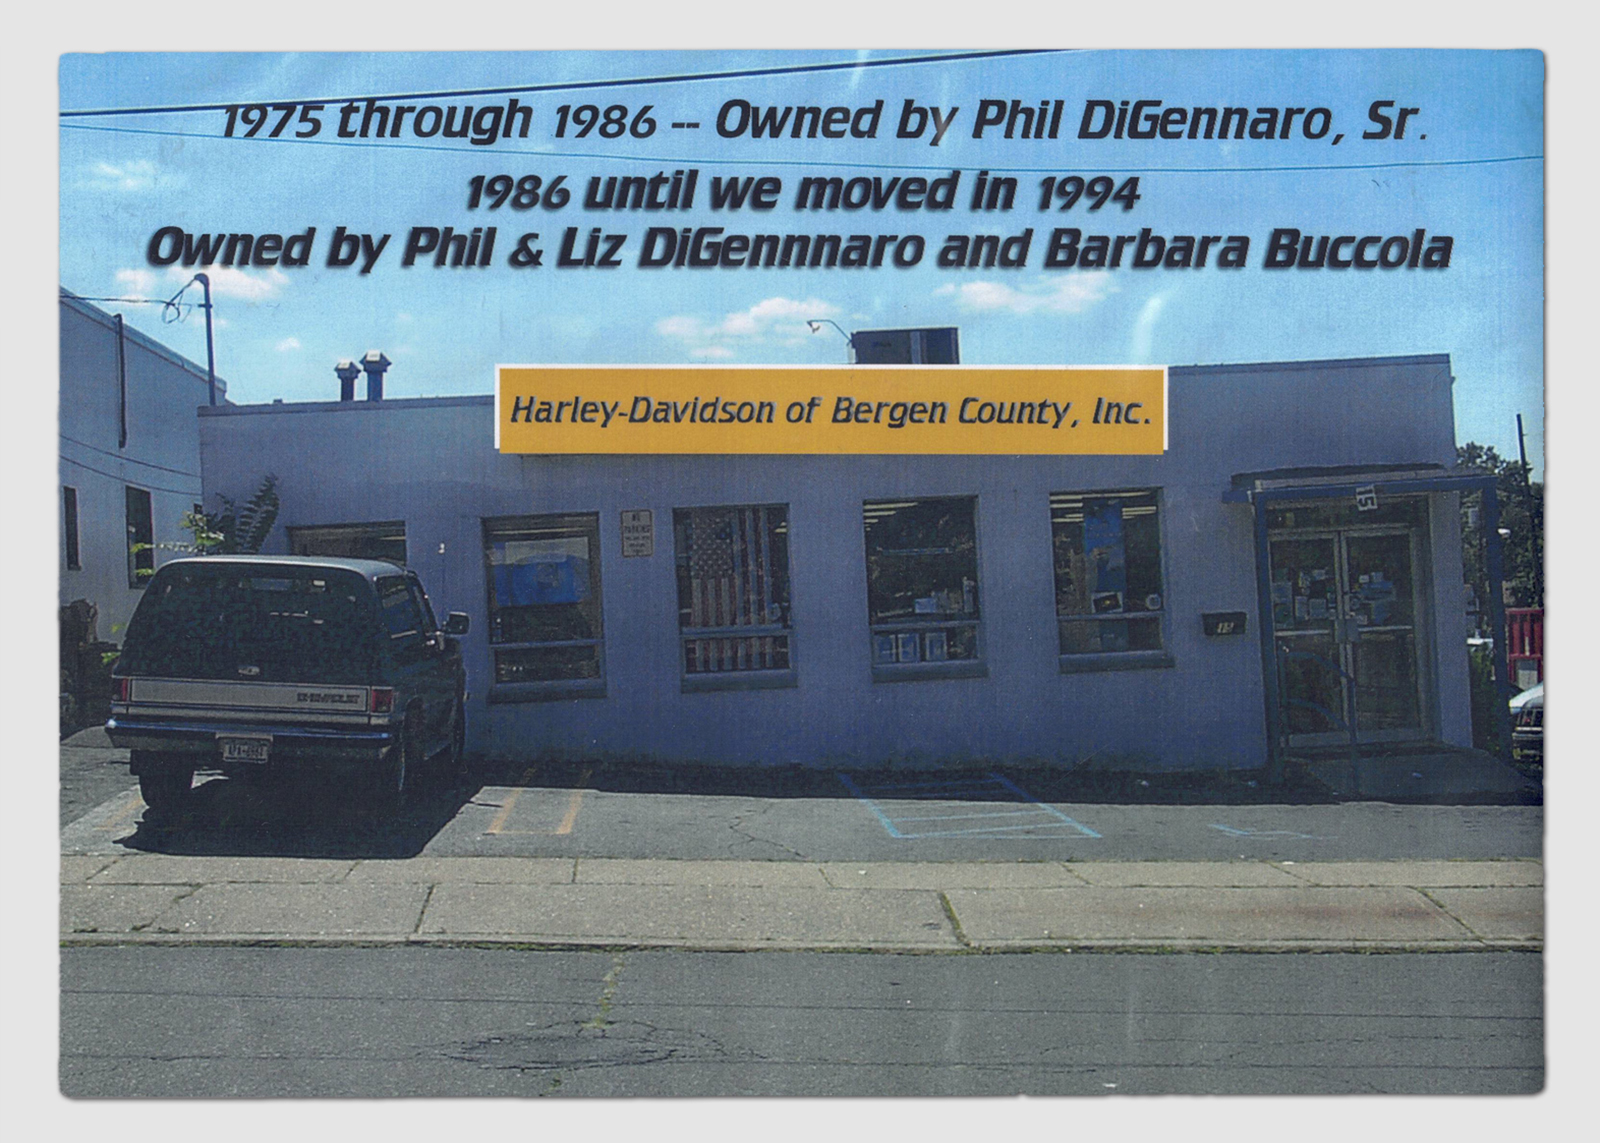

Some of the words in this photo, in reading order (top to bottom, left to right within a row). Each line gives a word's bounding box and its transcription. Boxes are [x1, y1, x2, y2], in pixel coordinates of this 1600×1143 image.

[510, 396, 775, 428] Harley-Davidson
[786, 396, 820, 423] of
[831, 397, 948, 429] Bergen
[958, 397, 1080, 429] County,
[1092, 397, 1152, 425] Inc.
